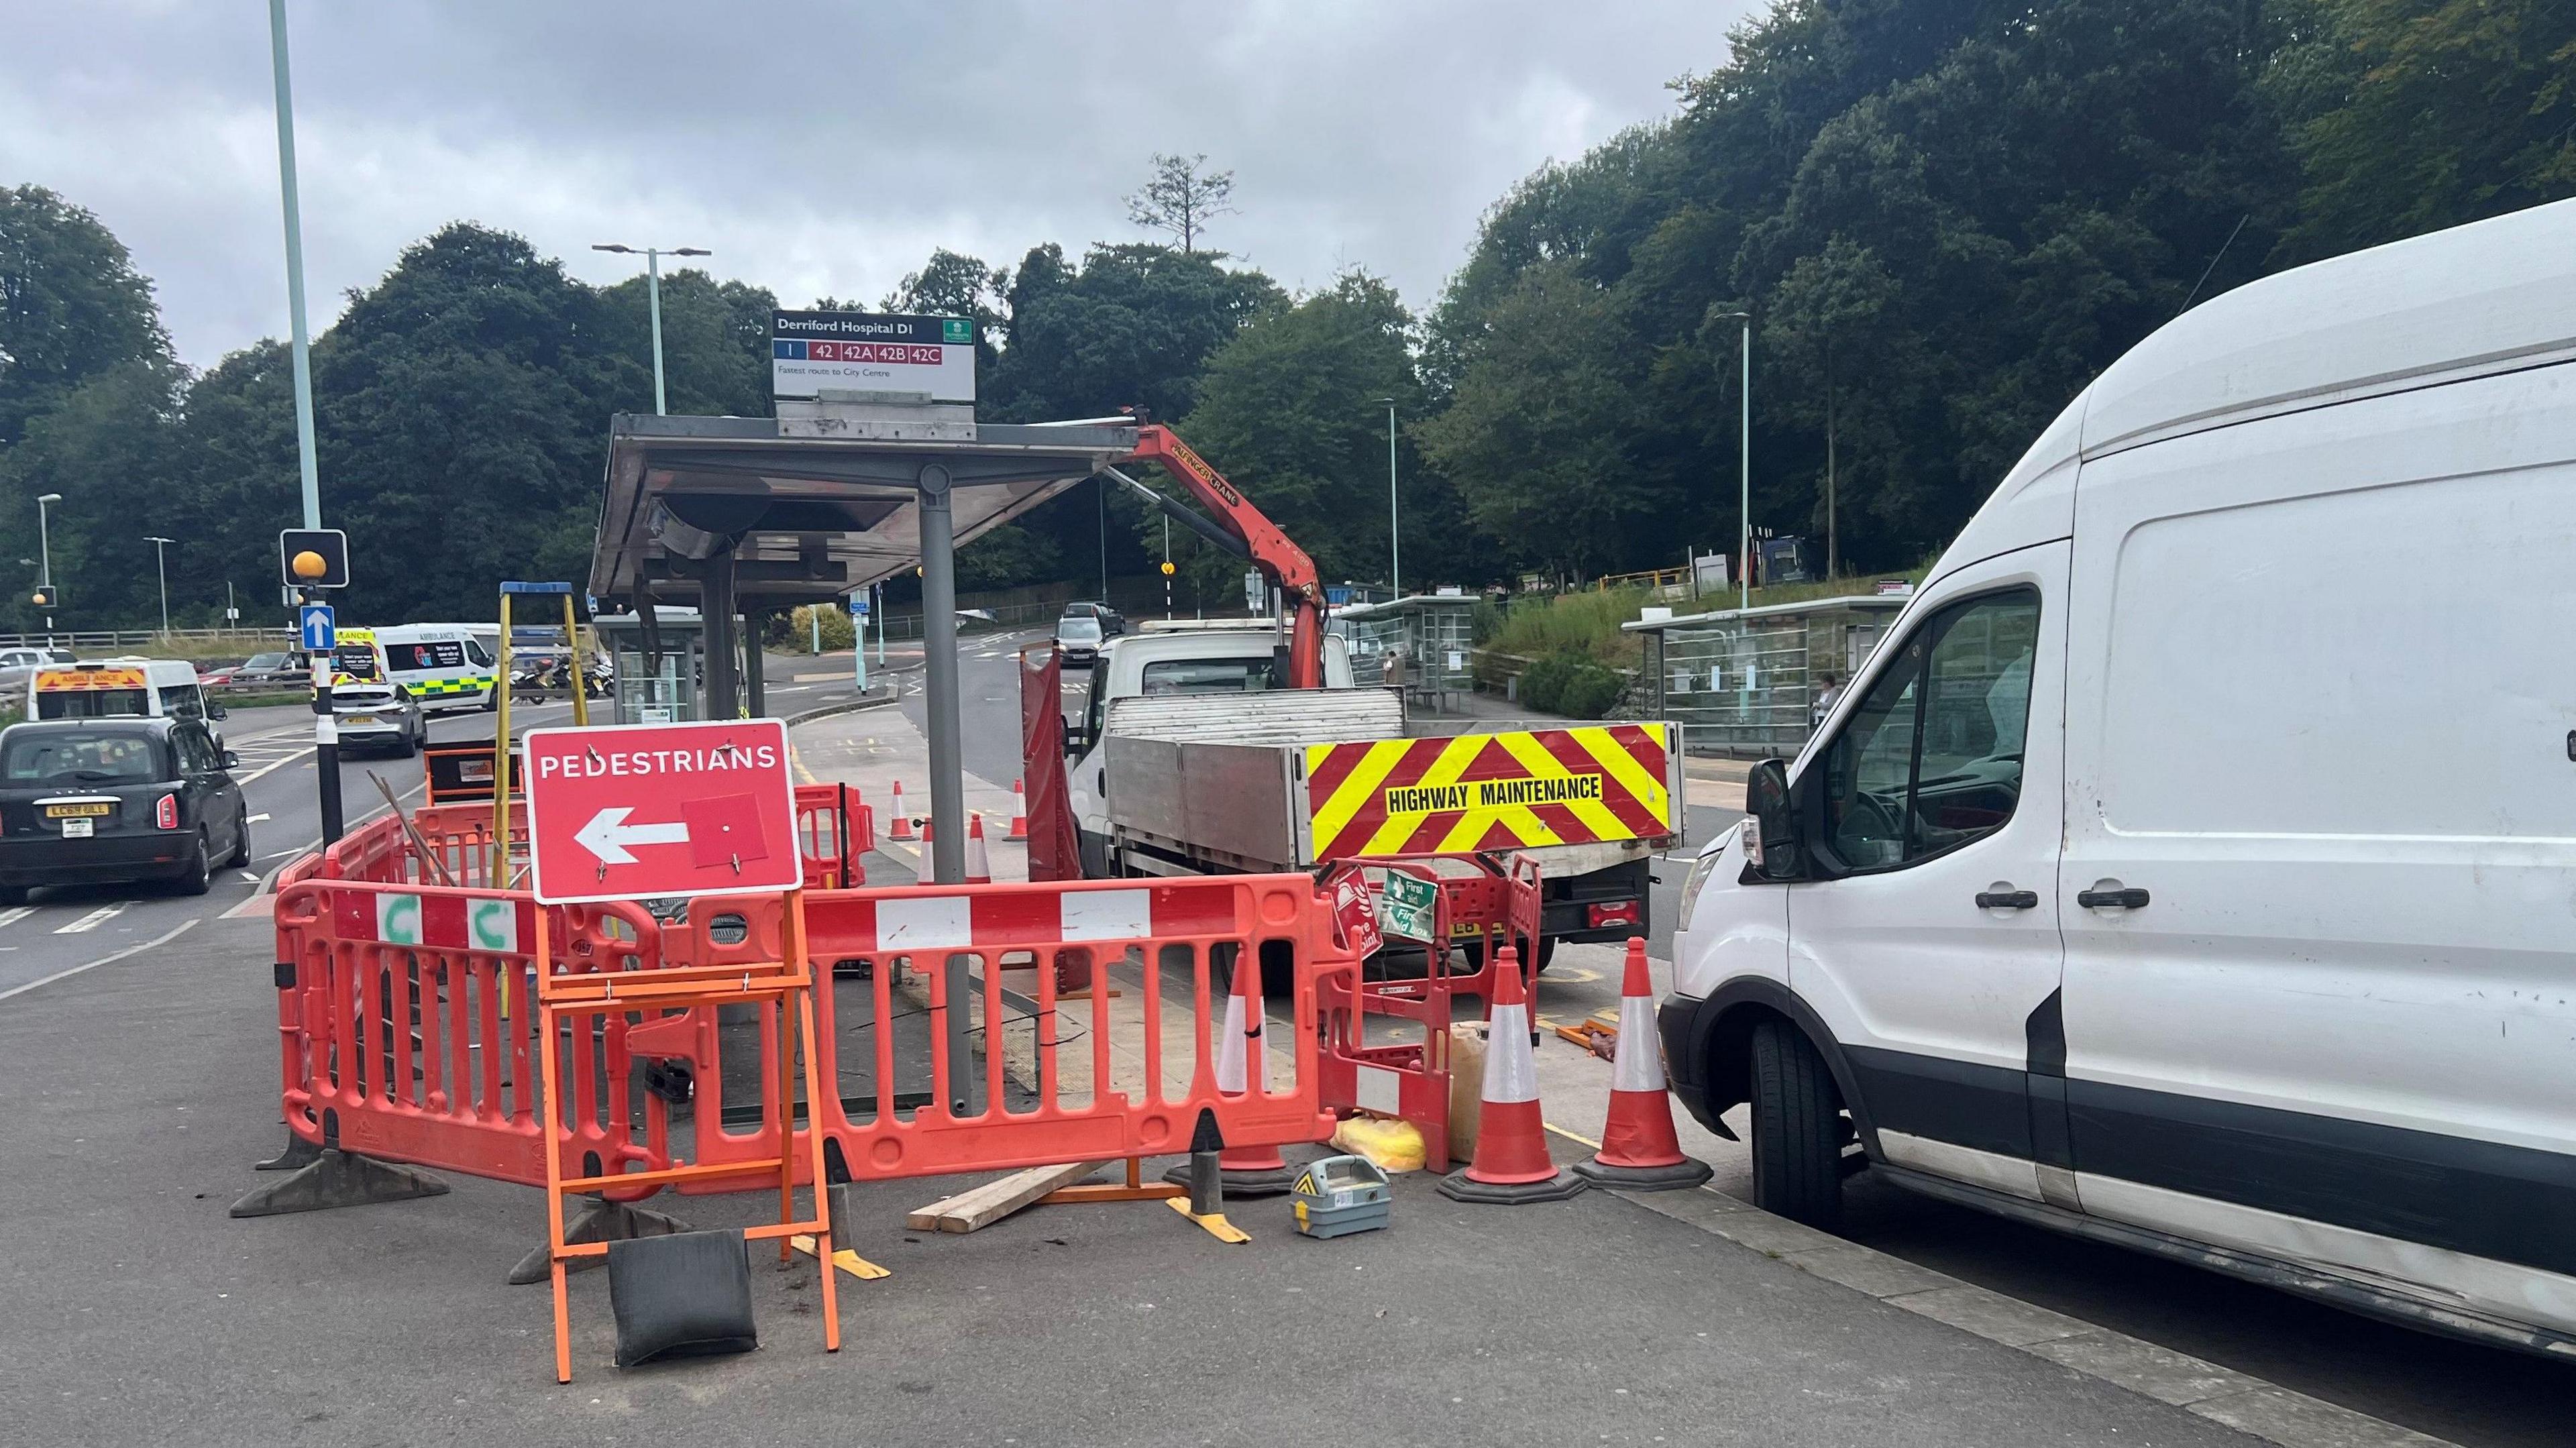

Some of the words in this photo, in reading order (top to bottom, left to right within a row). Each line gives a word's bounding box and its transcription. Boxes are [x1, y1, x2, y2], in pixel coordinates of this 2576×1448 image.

[777, 318, 838, 331] Derriford
[841, 321, 894, 335] Hospital
[816, 344, 833, 358] 42
[844, 345, 873, 359] 42A
[879, 347, 906, 360] 42B
[912, 348, 940, 362] 42C
[777, 366, 805, 374] Fastest
[843, 368, 859, 376] City
[862, 369, 890, 377] Centre
[540, 745, 776, 779] PEDESTRIANS
[1389, 785, 1468, 813] HIGHWAY
[1481, 776, 1600, 805] MAINTENANCE
[1406, 881, 1424, 895] First
[1360, 930, 1377, 952] oint
